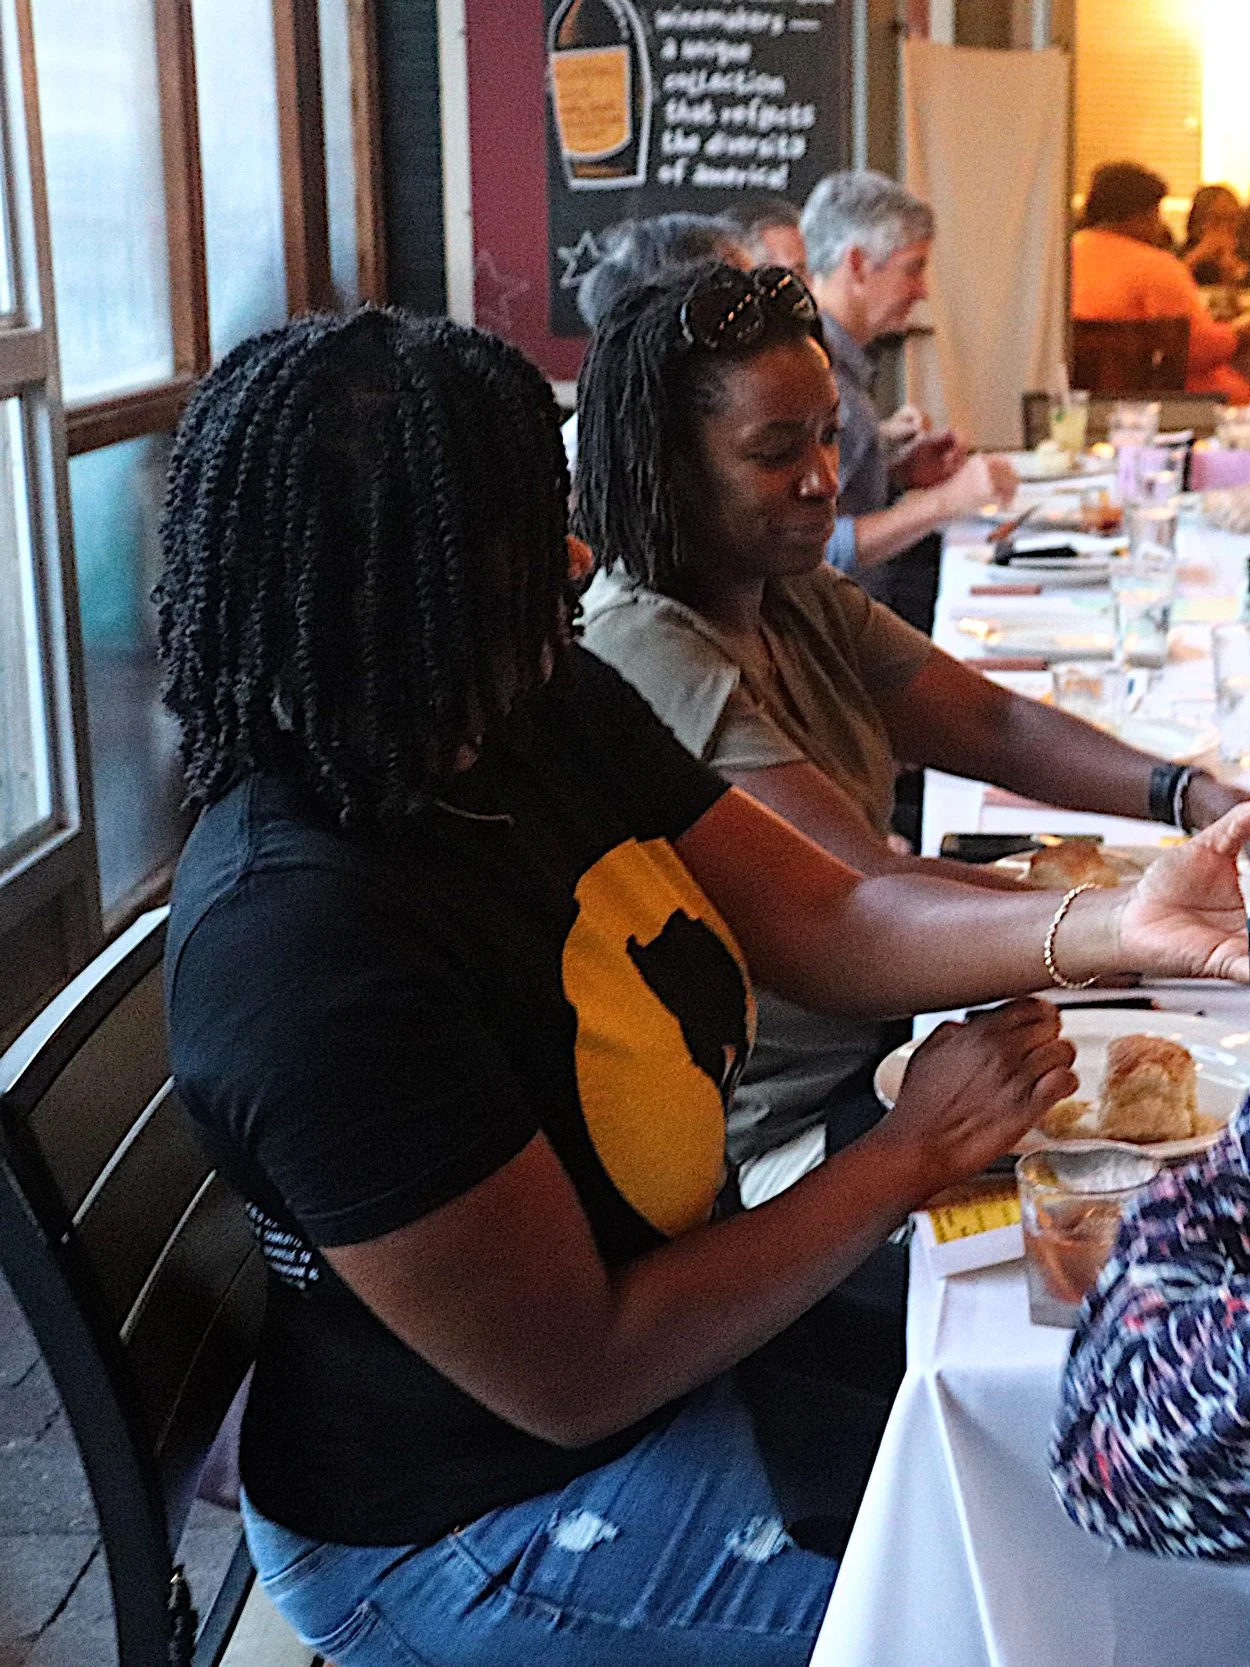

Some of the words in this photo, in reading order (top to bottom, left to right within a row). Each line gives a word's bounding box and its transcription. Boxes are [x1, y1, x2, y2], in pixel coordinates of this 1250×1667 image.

[664, 69, 786, 97] collection
[662, 128, 701, 156] the
[658, 157, 689, 185] of
